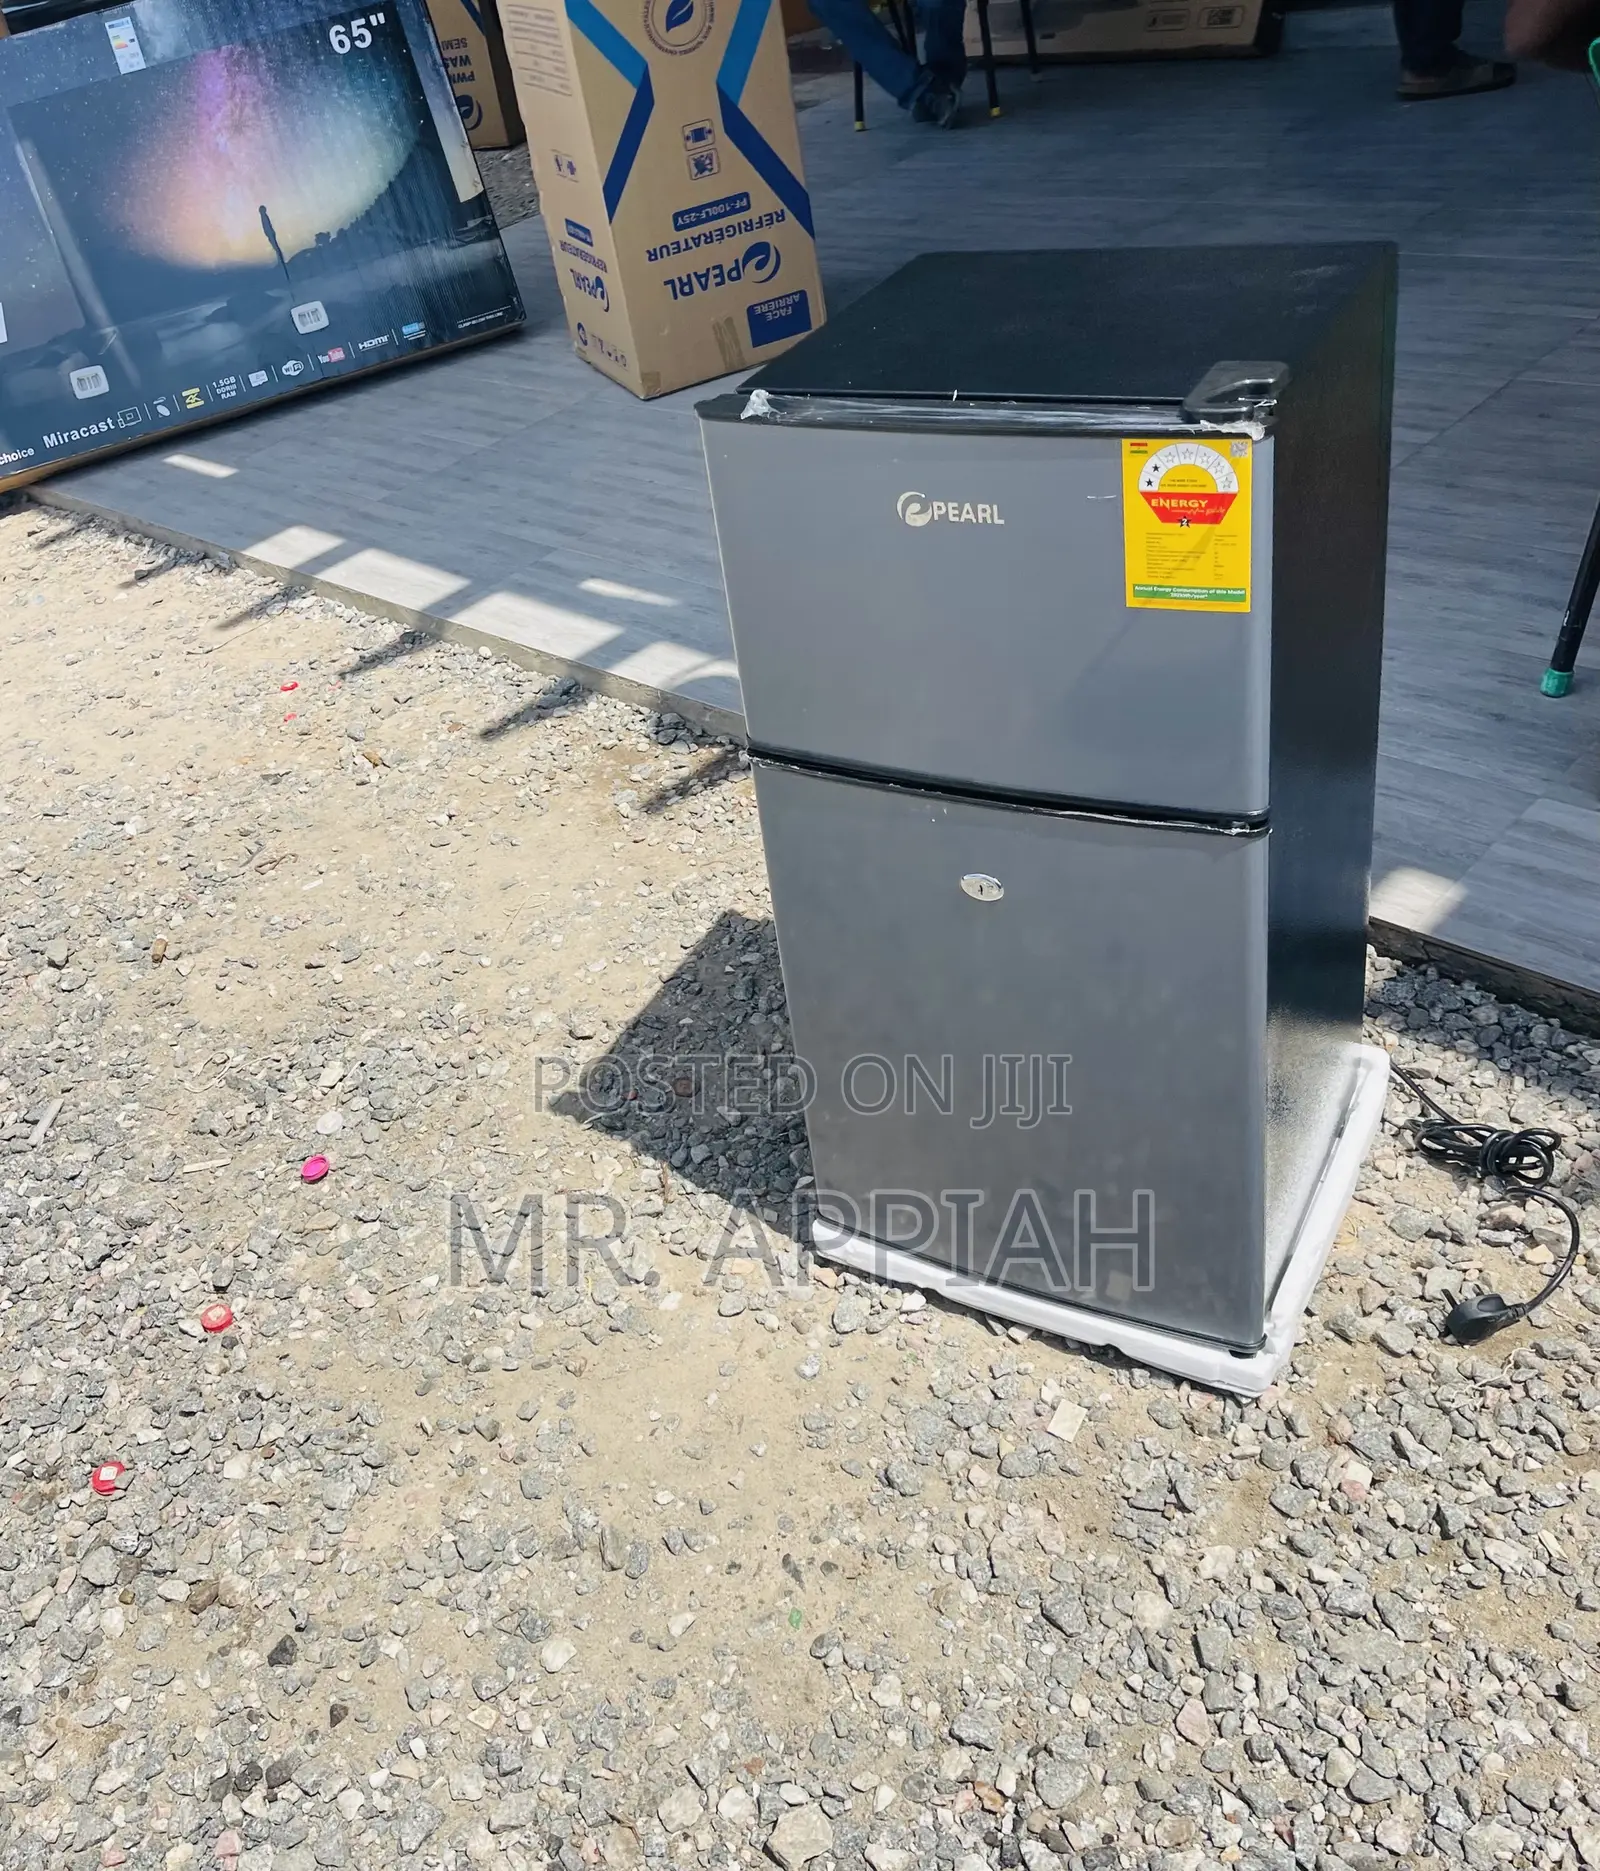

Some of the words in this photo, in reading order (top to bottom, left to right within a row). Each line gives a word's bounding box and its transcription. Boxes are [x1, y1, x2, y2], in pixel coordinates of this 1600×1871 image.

[329, 12, 385, 54] 65"
[645, 208, 786, 262] RÉFRIGÉRATEUR
[663, 258, 743, 300] PEARL
[766, 306, 792, 321] FACE
[359, 334, 389, 350] HDMI
[212, 376, 236, 388] 1.5GB
[221, 391, 237, 400] RAM
[42, 416, 115, 449] Miracast
[932, 500, 1005, 525] PEARL
[1151, 497, 1209, 510] ENERGY
